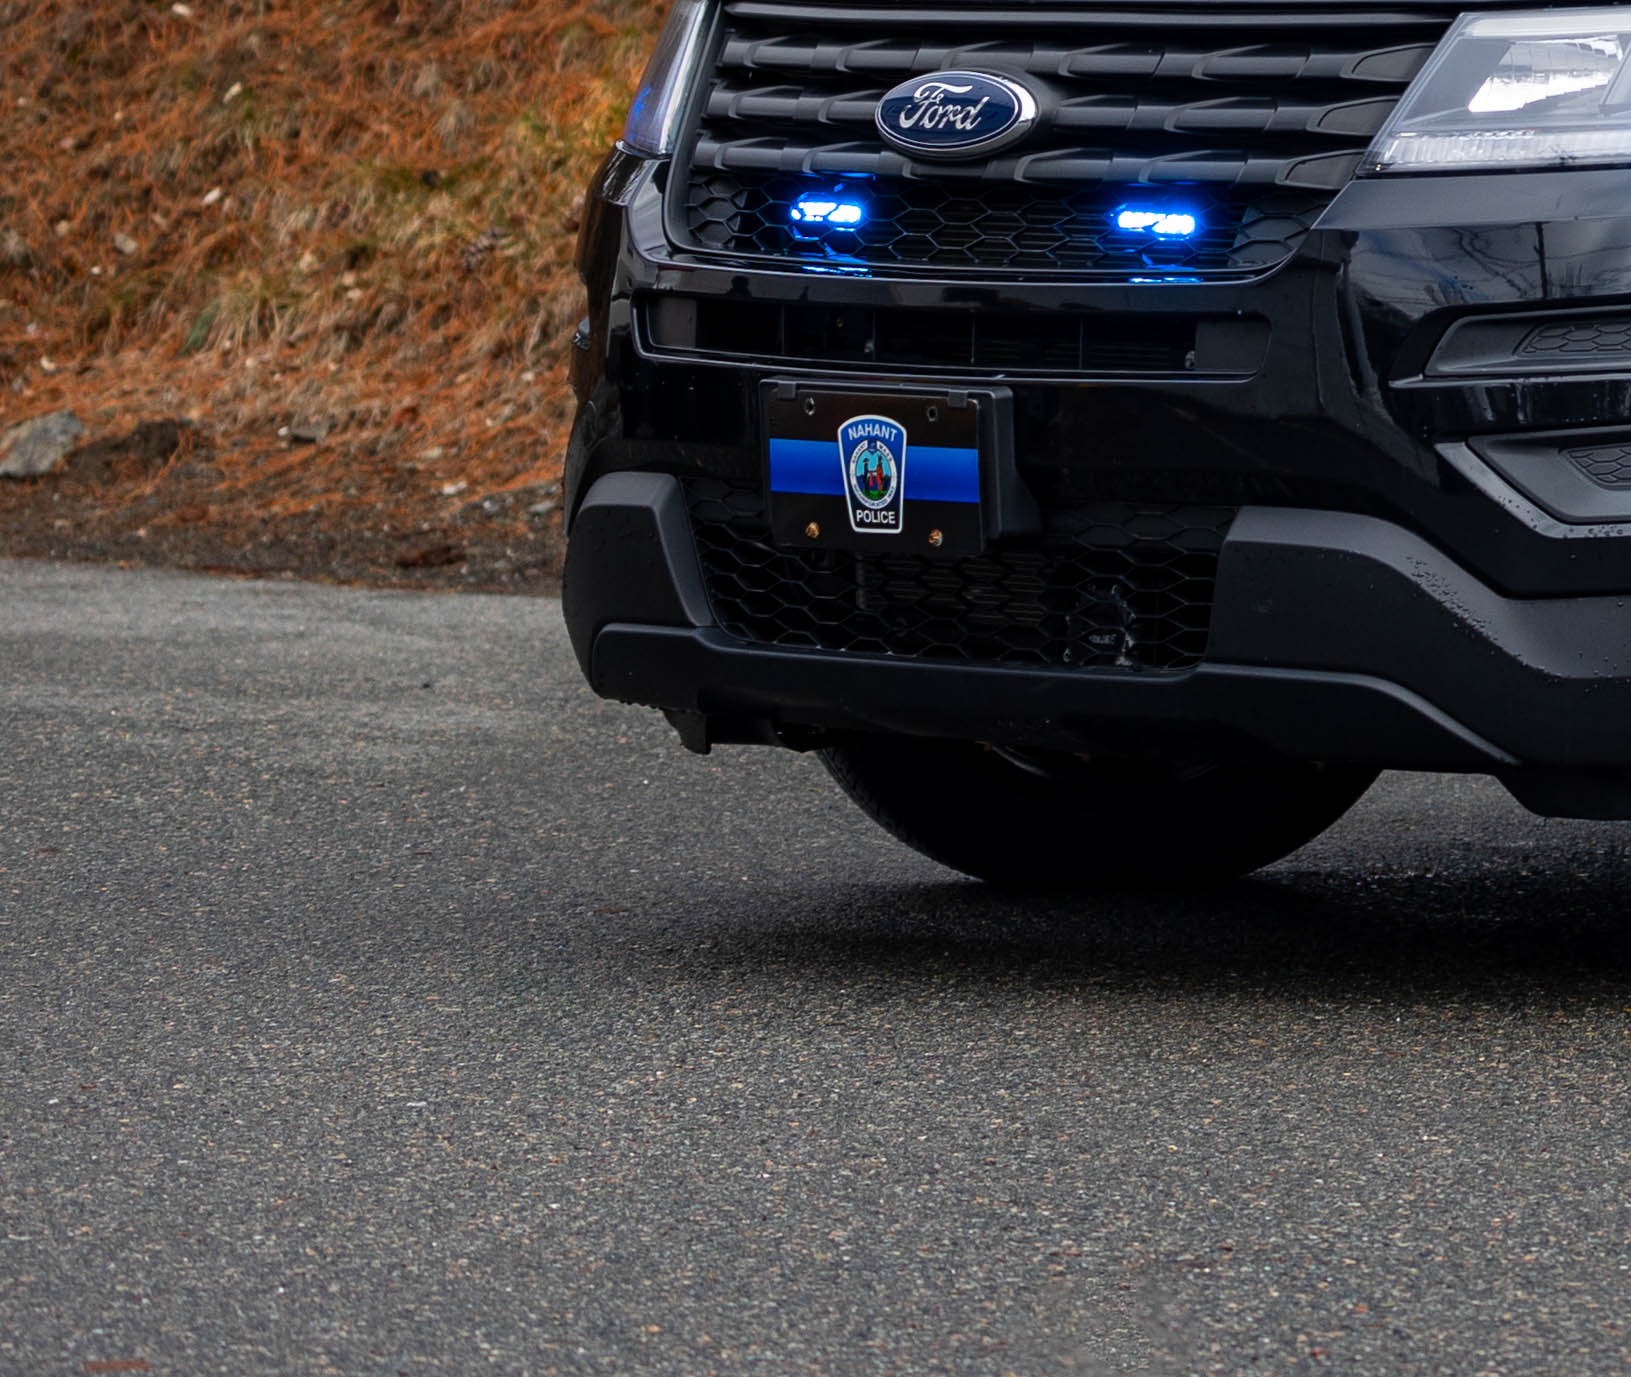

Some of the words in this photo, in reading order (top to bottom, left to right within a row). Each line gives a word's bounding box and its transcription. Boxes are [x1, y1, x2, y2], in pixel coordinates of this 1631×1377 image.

[899, 82, 990, 130] Ford
[848, 423, 898, 442] NAHANT
[856, 509, 896, 524] POLICE
